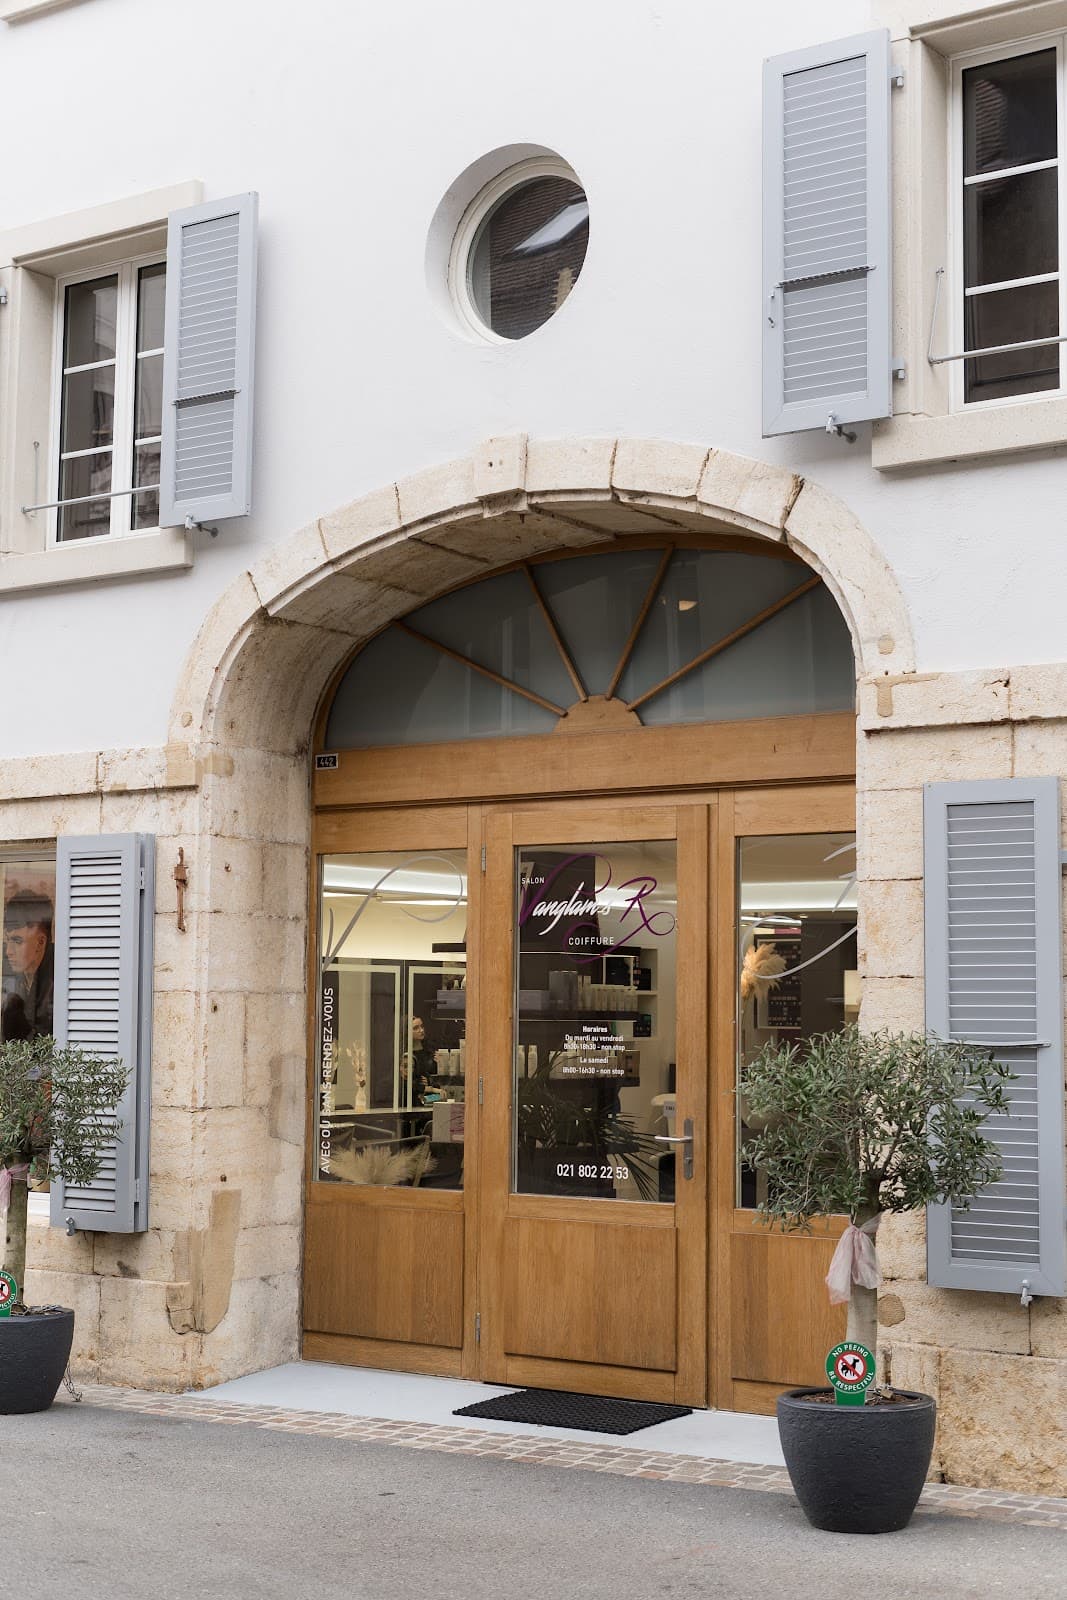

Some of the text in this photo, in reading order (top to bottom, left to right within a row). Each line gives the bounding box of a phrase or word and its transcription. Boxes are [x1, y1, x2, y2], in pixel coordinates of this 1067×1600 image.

[320, 757, 334, 767] 442
[521, 876, 545, 885] SALON
[568, 937, 615, 946] COIFFURE
[574, 1034, 591, 1042] mardi
[588, 1056, 609, 1064] samedi
[321, 987, 334, 1174] AVEC OU SANS RENDEZ-VOUS
[556, 1164, 629, 1179] 021 802 22 53
[832, 1343, 869, 1358] NO PEEING
[828, 1370, 874, 1391] BE RESPECTFUL
